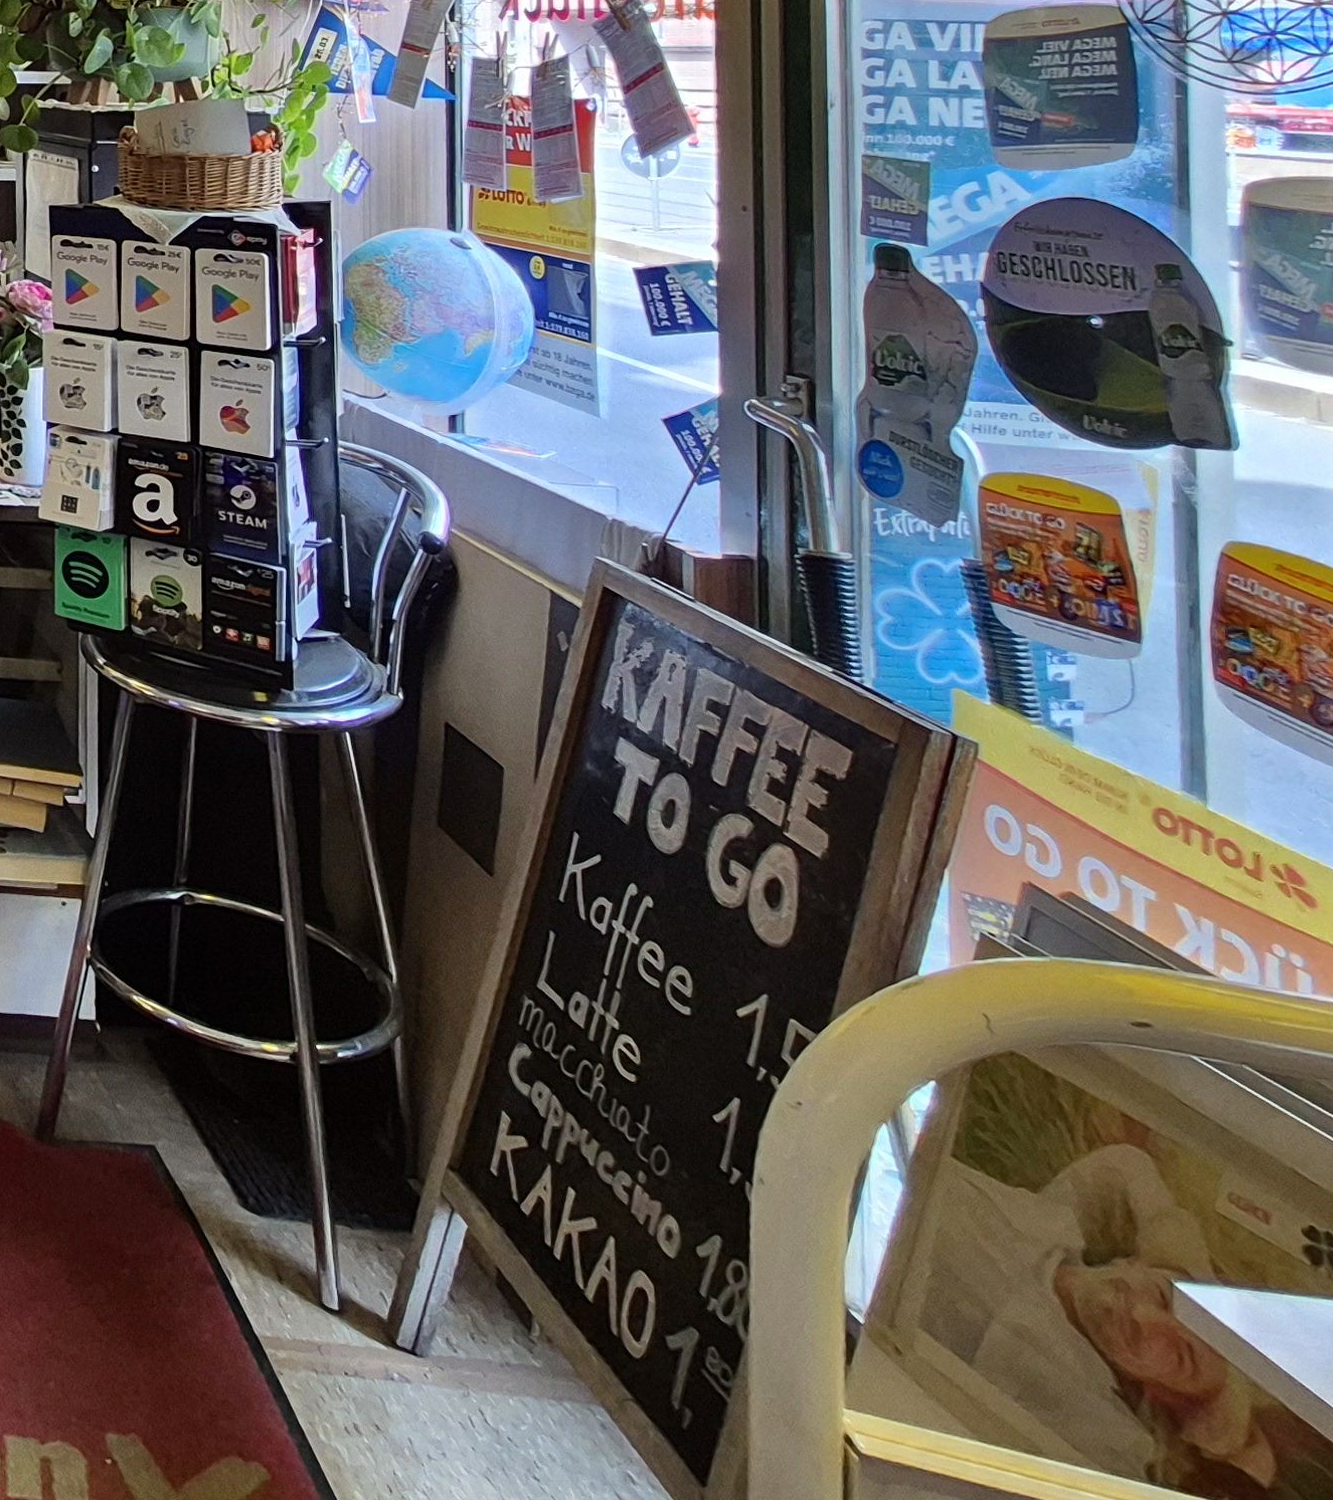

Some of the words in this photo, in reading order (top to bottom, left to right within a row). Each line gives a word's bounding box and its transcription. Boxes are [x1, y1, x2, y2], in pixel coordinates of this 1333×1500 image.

[57, 251, 87, 264] Google
[89, 255, 108, 265] Play
[127, 257, 159, 270] Google
[161, 261, 180, 274] Play
[202, 266, 237, 279] Google
[239, 270, 259, 281] Play
[996, 251, 1137, 291] GESCHLOSSEN
[664, 273, 694, 326] GEHALT
[971, 423, 1007, 437] Hilfe
[1012, 427, 1053, 440] unter
[133, 473, 178, 525] a
[218, 510, 268, 529] STEAM
[601, 617, 853, 860] KAFFEE
[613, 736, 692, 855] TO
[706, 813, 800, 947] GO
[558, 831, 694, 1016] Kaffee
[519, 995, 670, 1176] macchiato
[536, 930, 641, 1082] Latte
[712, 1097, 752, 1200] 1,
[508, 1042, 682, 1259] Cappuccino
[489, 1110, 656, 1359] KAKAO
